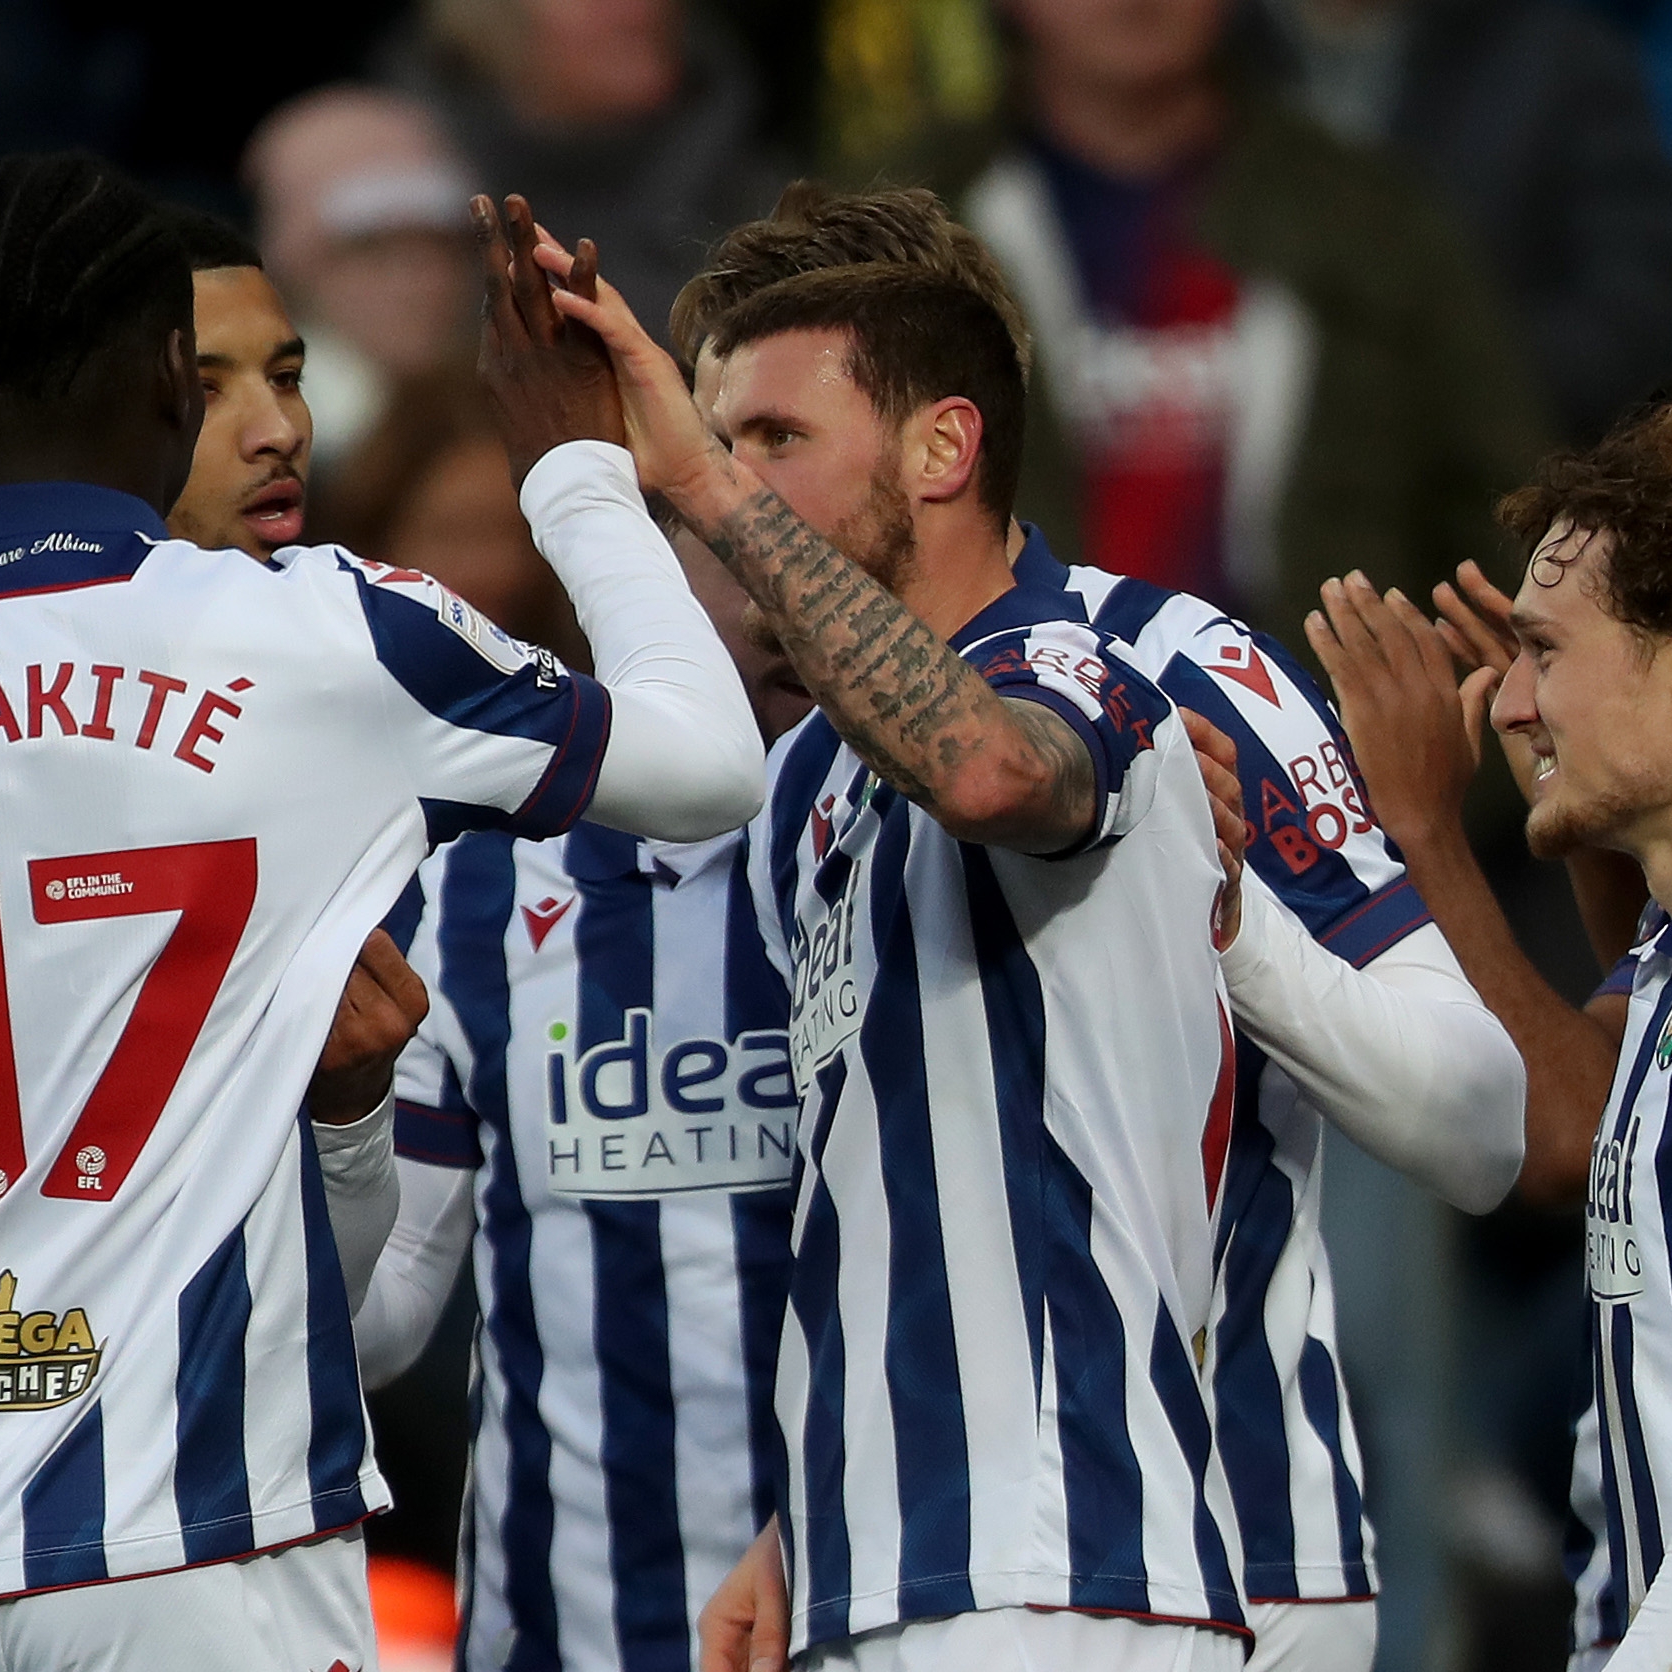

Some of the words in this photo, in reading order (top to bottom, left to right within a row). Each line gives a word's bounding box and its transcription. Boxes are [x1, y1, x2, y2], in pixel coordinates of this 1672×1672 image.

[30, 533, 104, 554] Albion
[66, 876, 86, 889] EFL
[87, 874, 100, 887] IN
[101, 872, 122, 884] THE
[68, 881, 134, 900] COMMUNITY
[547, 1013, 799, 1125] idea
[548, 1122, 791, 1176] HEATIN
[77, 1176, 103, 1191] EFL
